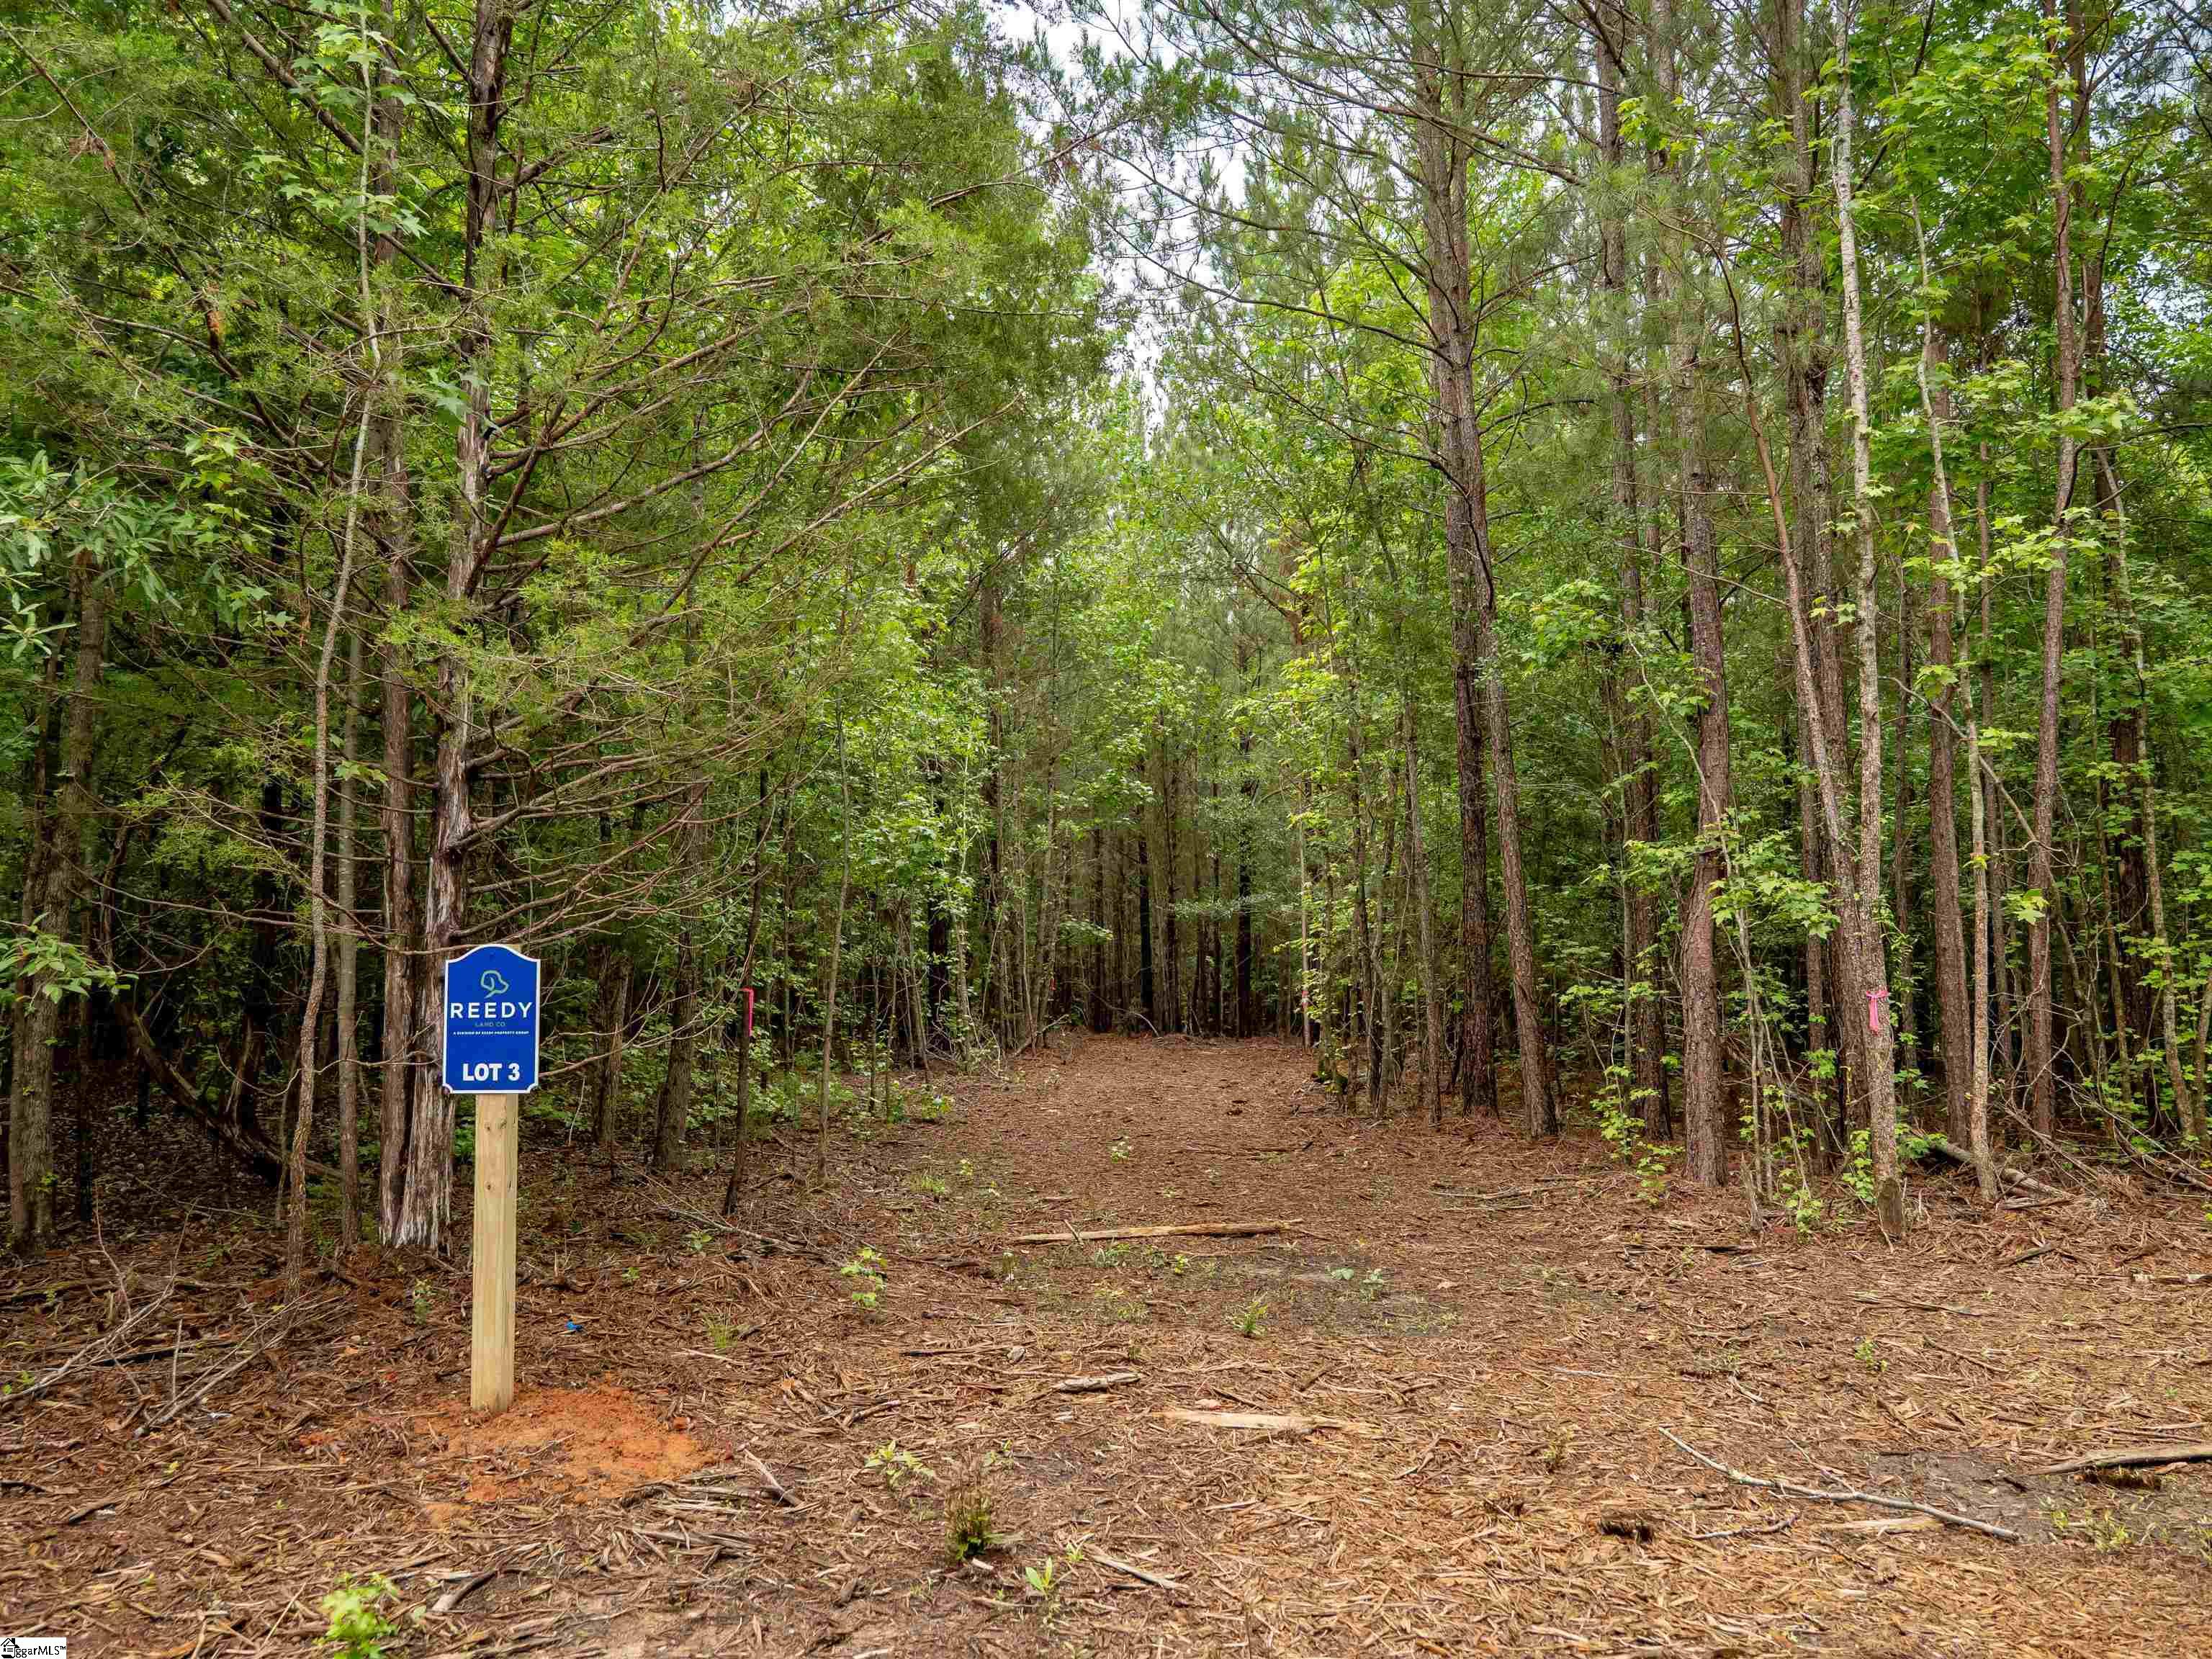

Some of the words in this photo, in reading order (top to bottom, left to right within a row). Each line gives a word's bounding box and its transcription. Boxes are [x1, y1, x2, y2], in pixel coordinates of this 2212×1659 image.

[450, 1002, 533, 1019] REEDY
[462, 1063, 503, 1082] LOT
[508, 1063, 521, 1082] 3
